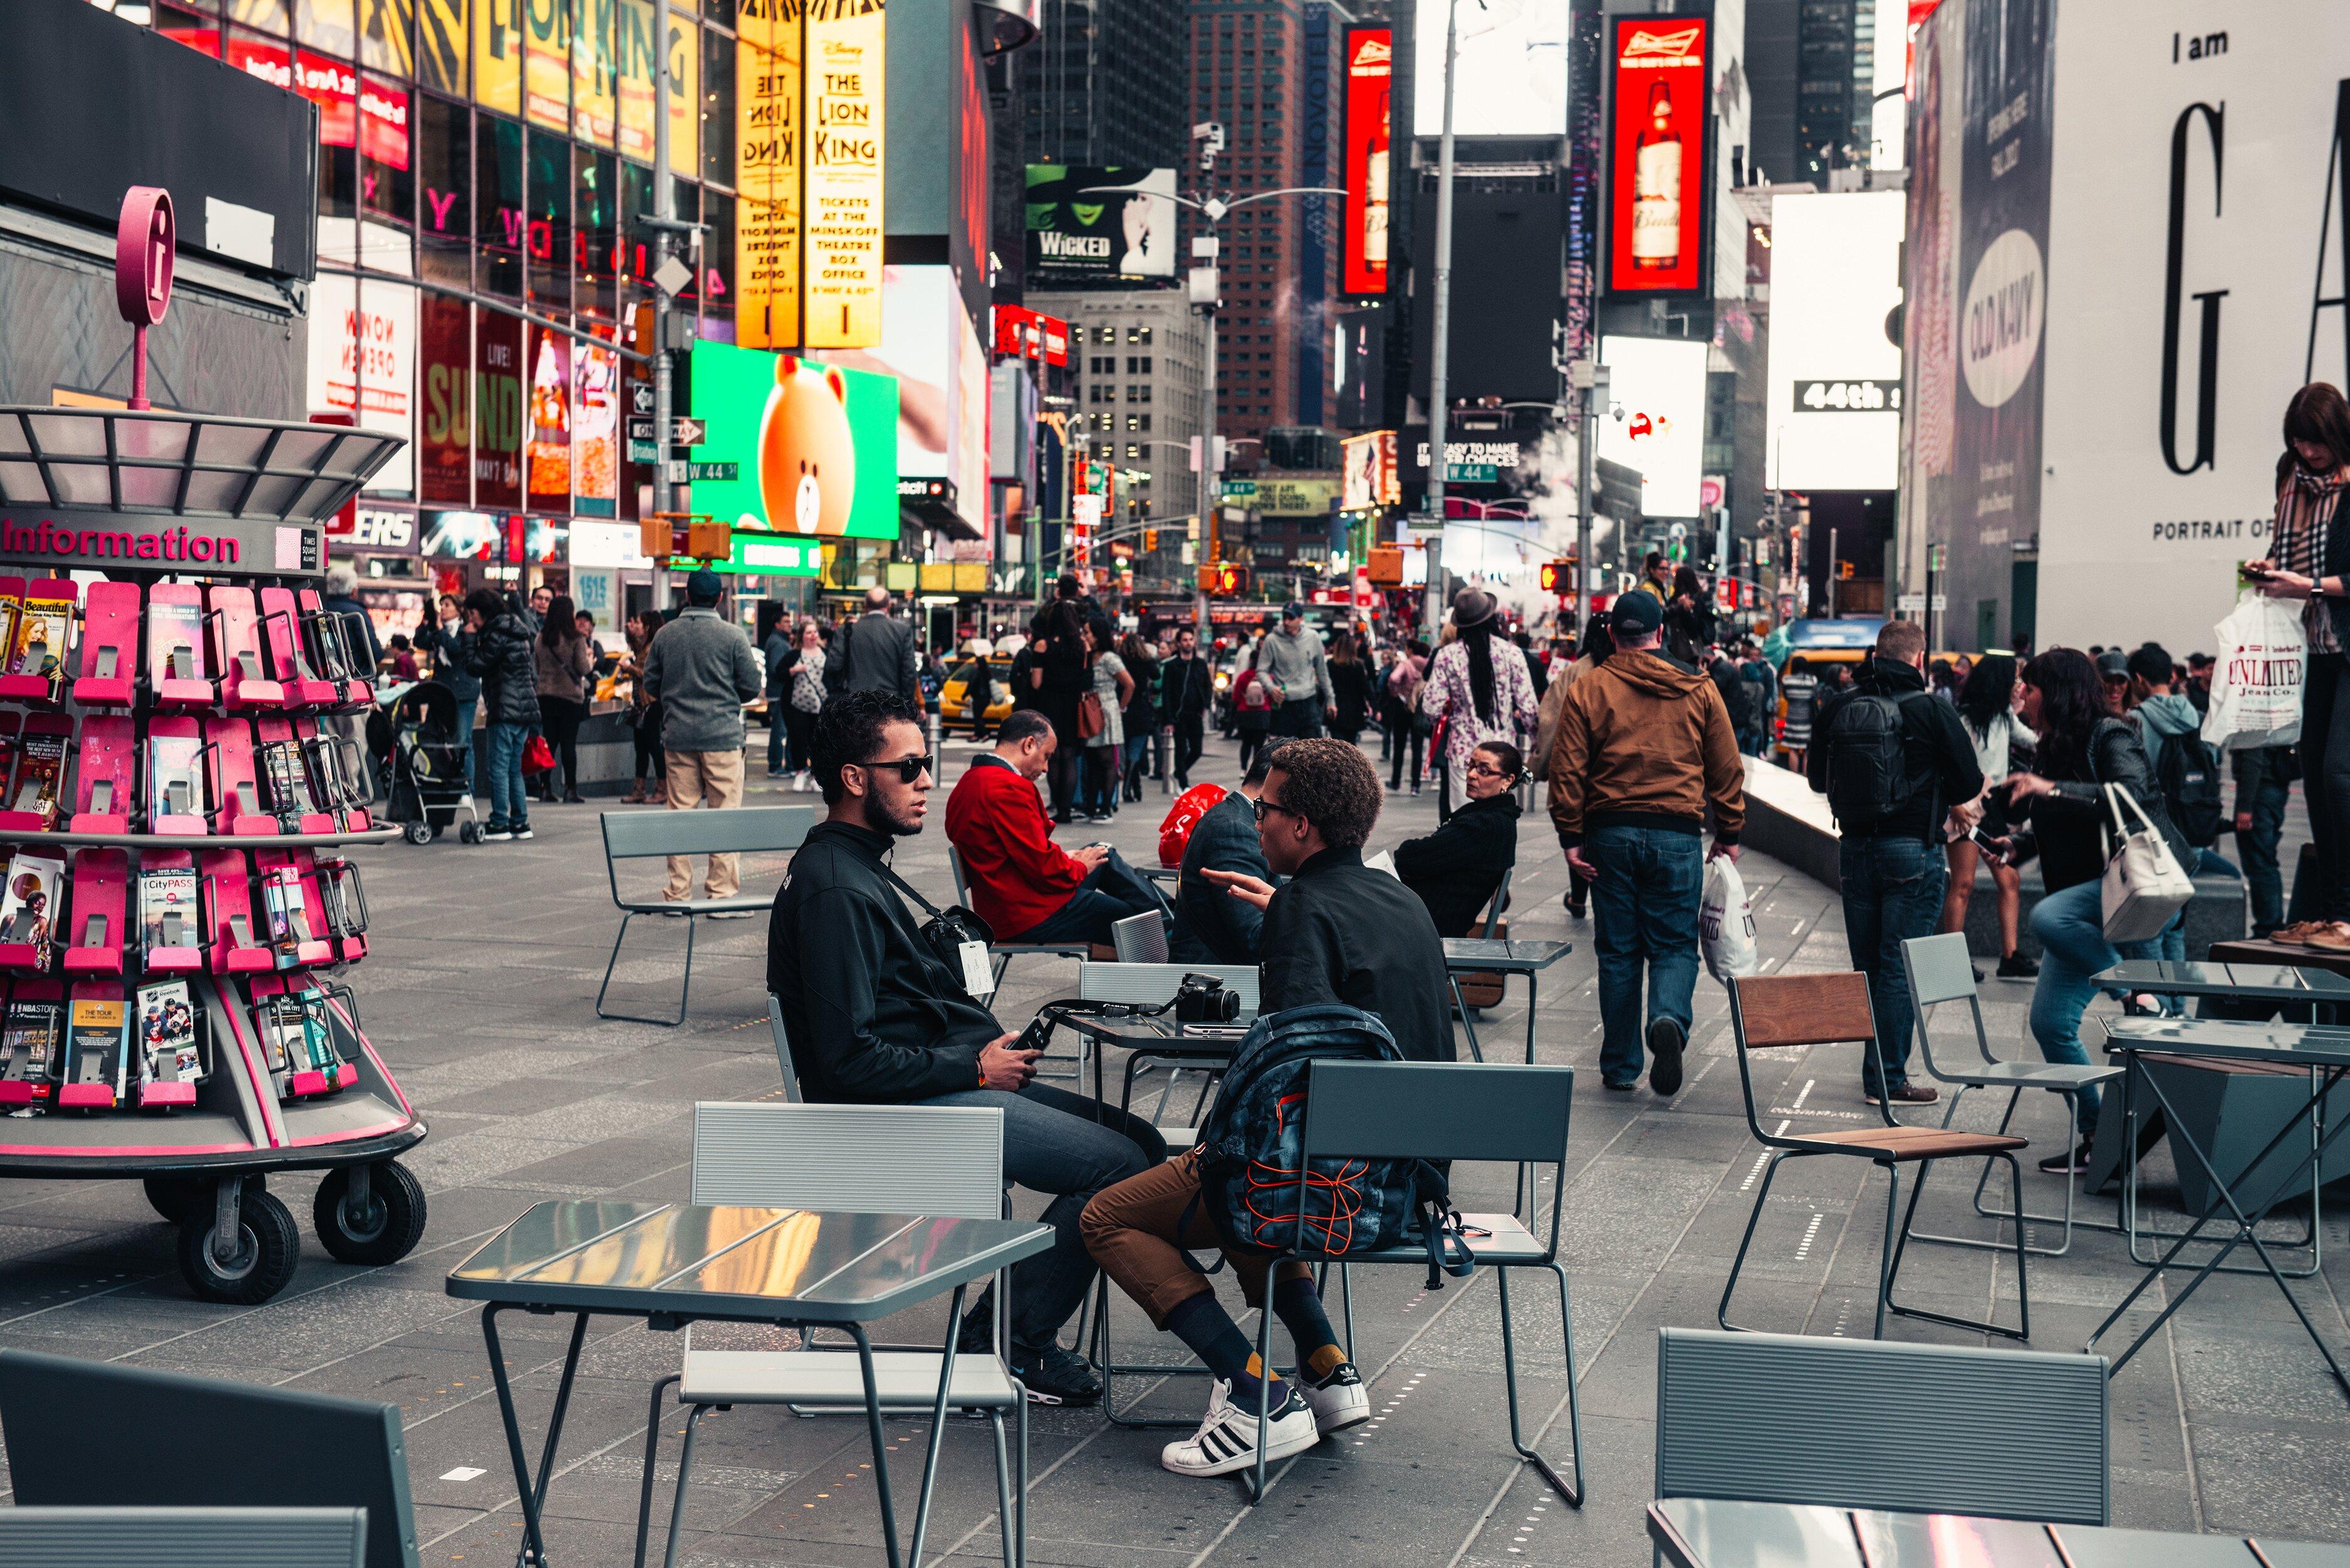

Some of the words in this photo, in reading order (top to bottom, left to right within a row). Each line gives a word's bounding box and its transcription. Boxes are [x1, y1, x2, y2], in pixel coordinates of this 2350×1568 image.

[2173, 33, 2179, 63] I
[2188, 29, 2229, 60] am
[824, 75, 860, 90] THE
[819, 97, 869, 126] LION
[815, 130, 876, 166] KING
[819, 198, 869, 208] TICKETS
[823, 212, 837, 221] AT
[844, 212, 865, 221] THE
[811, 226, 878, 237] MINSKOFF
[817, 241, 871, 250] THEATRE
[830, 255, 858, 265] BOX
[822, 269, 865, 279] OFFICE
[1971, 294, 1994, 363] OLD
[1996, 270, 2035, 353] NAVY
[487, 344, 511, 367] LIVE!
[1803, 375, 1884, 409] 44th
[428, 363, 533, 453] SUND
[689, 464, 701, 480] W
[706, 464, 723, 479] 44
[1449, 465, 1460, 479] W
[1464, 465, 1482, 479] 44
[2154, 520, 2243, 541] PORTRAIT
[3, 519, 240, 562] Information
[304, 537, 316, 546] TIMES
[302, 546, 316, 556] SQUARE
[25, 601, 67, 613] Beautiful
[2239, 688, 2270, 697] Jean
[149, 879, 193, 889] CityPASS
[159, 988, 181, 997] Reebok
